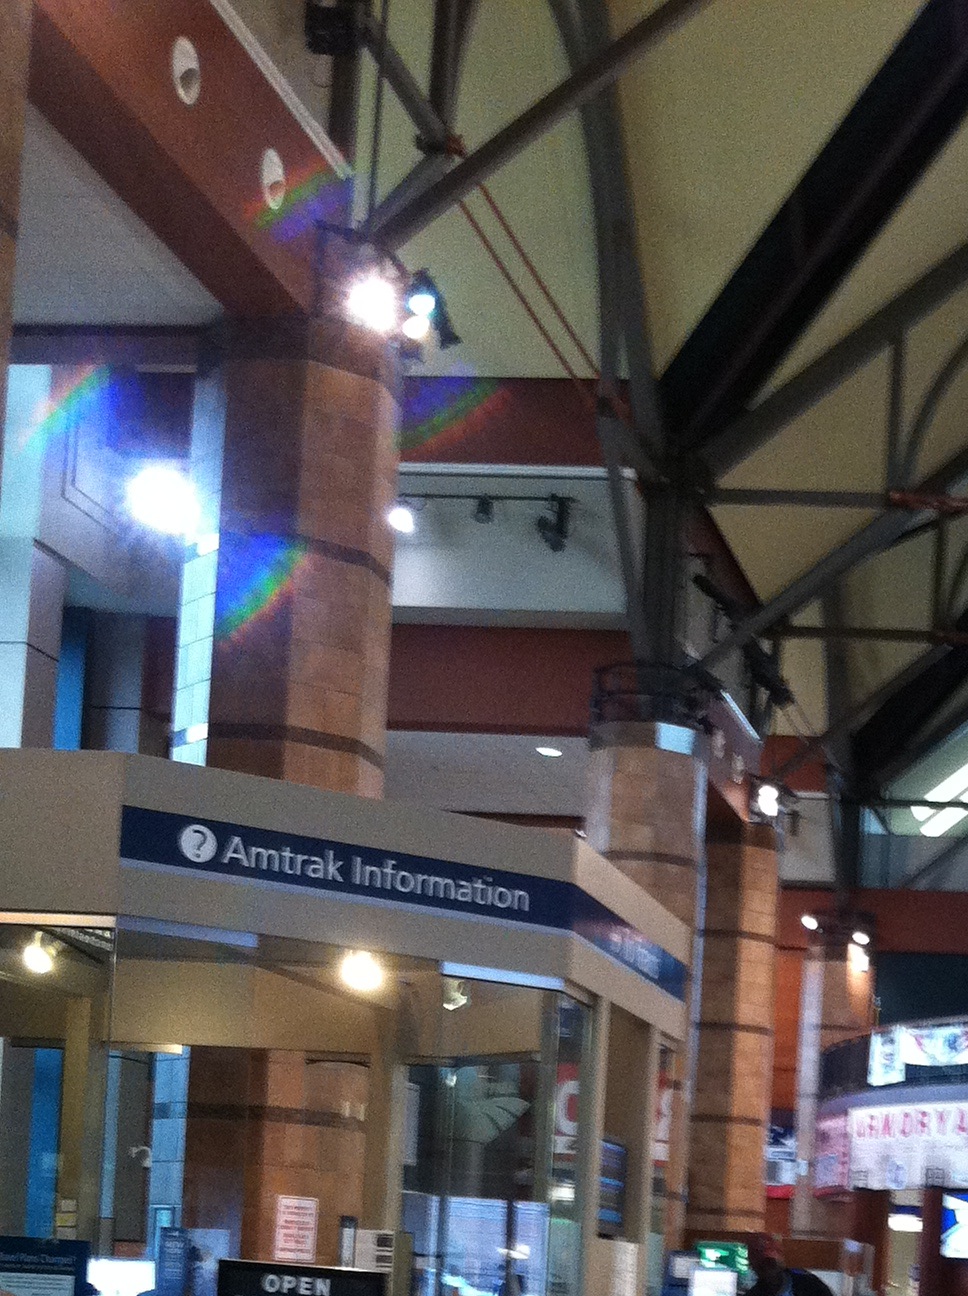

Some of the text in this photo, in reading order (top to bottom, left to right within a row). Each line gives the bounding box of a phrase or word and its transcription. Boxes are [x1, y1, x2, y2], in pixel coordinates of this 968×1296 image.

[221, 835, 344, 882] Amtrak
[351, 856, 531, 912] Information
[261, 1273, 331, 1296] OPEN
